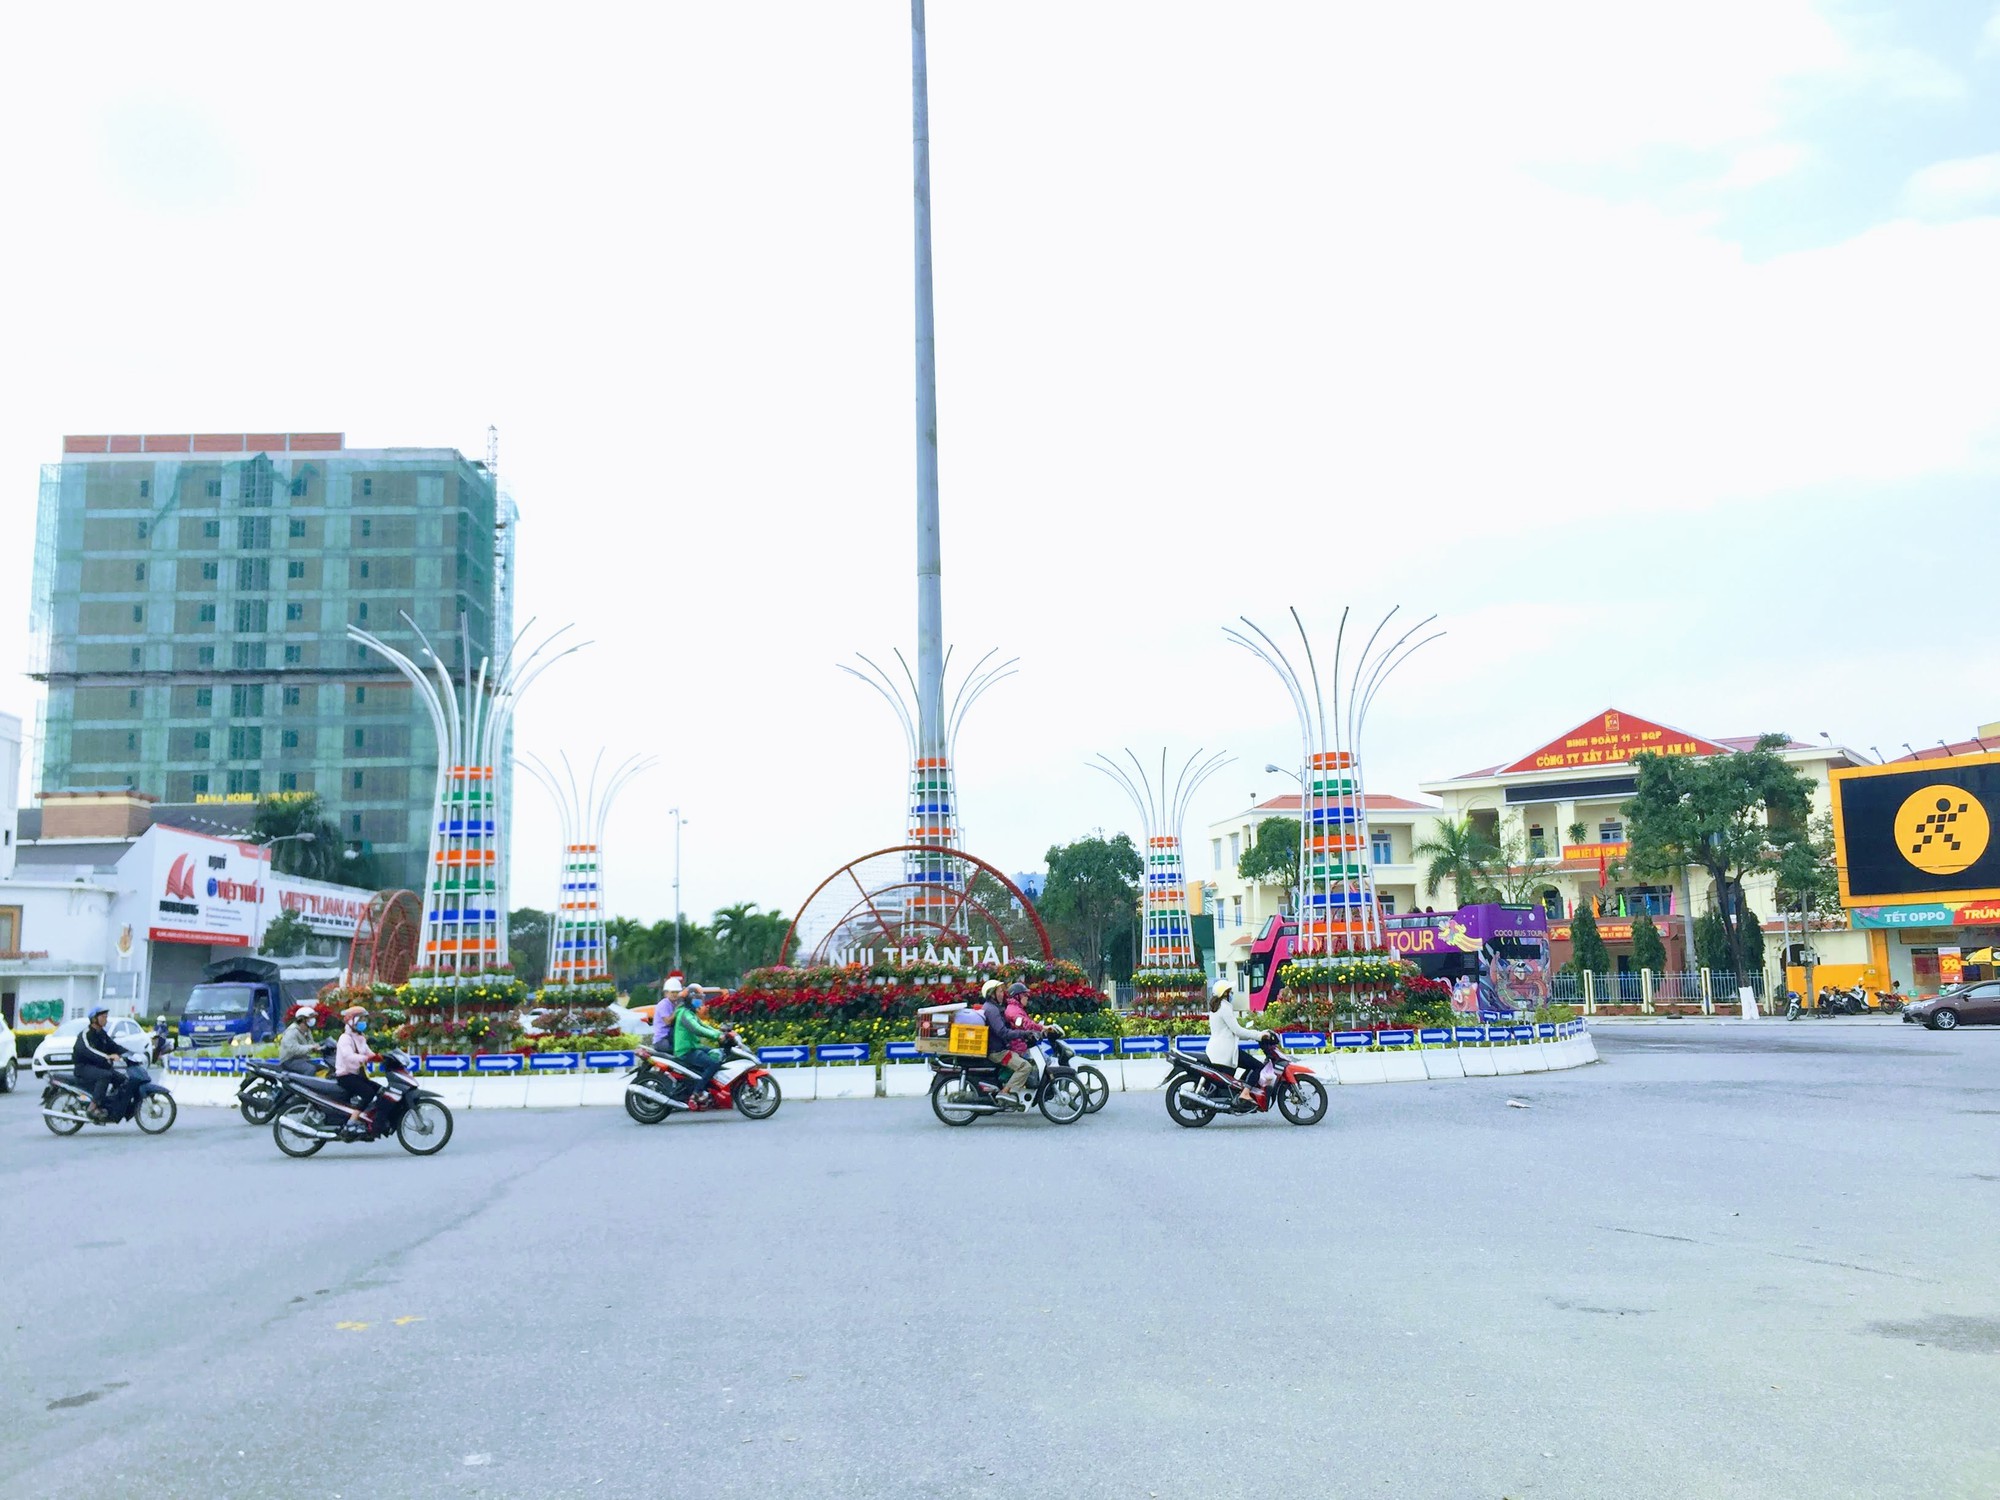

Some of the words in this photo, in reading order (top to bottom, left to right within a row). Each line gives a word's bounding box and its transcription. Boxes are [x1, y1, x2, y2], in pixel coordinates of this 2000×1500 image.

[1566, 738, 1588, 748] BINH
[1591, 732, 1618, 745] ĐOÀN
[1621, 733, 1631, 743] 11
[1641, 731, 1662, 741] BQP
[1536, 753, 1564, 767] CÔNG
[1566, 753, 1580, 764] TY
[1582, 749, 1602, 762] XÂY
[1606, 745, 1625, 760] LẮP
[1667, 744, 1682, 755] AN
[196, 793, 223, 804] DANA
[226, 792, 253, 802] HOME
[1884, 910, 1907, 922] TẾT
[1909, 911, 1945, 921] OPPO
[1387, 930, 1434, 952] TOUR
[1494, 929, 1513, 937] COCO
[1514, 929, 1526, 937] BUS
[1528, 929, 1544, 937] TOUR
[829, 943, 874, 967] NÚI
[967, 940, 1009, 966] TÀI
